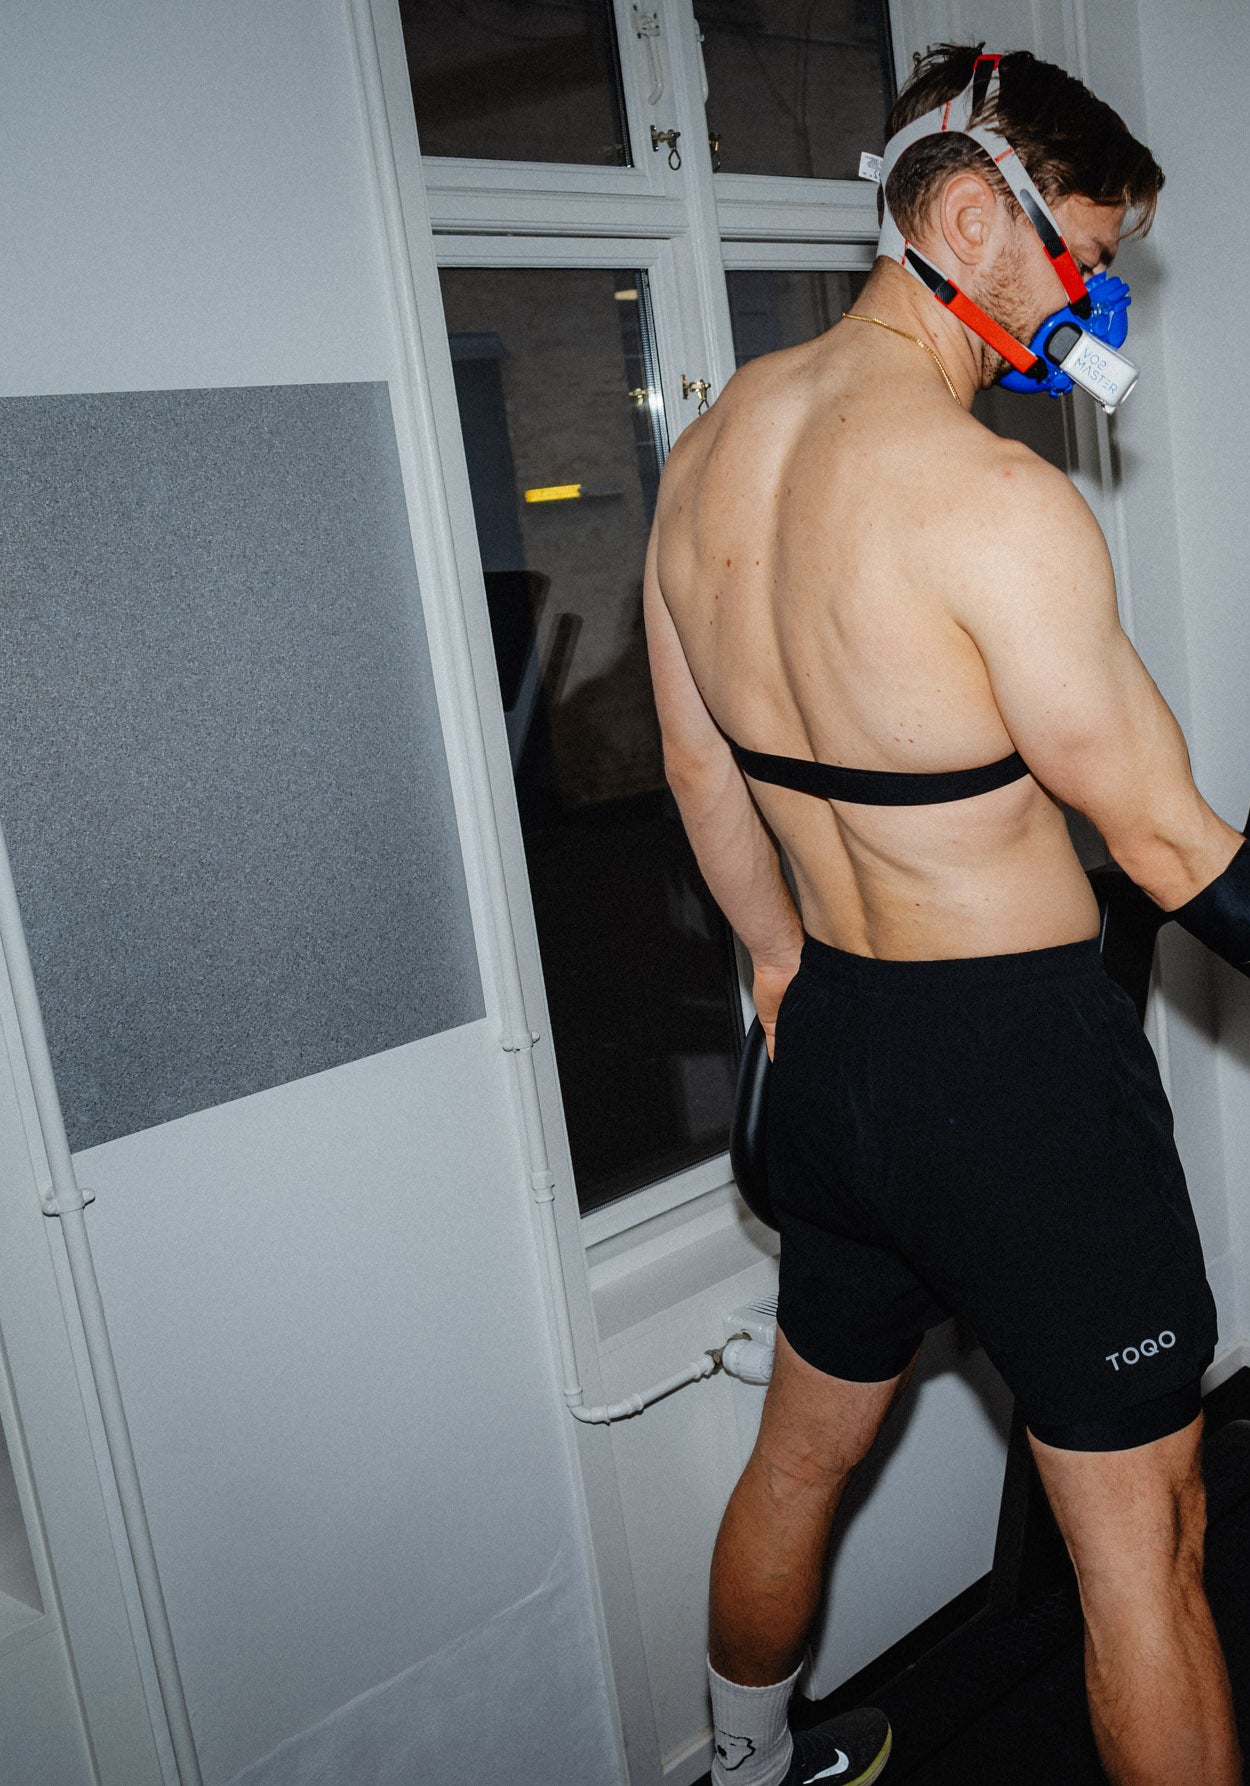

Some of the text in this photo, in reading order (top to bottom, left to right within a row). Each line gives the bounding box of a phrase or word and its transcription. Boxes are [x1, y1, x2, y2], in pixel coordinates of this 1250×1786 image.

[1075, 358, 1118, 394] MASTER
[1083, 347, 1107, 370] VO2
[1105, 1330, 1176, 1371] TOQO
